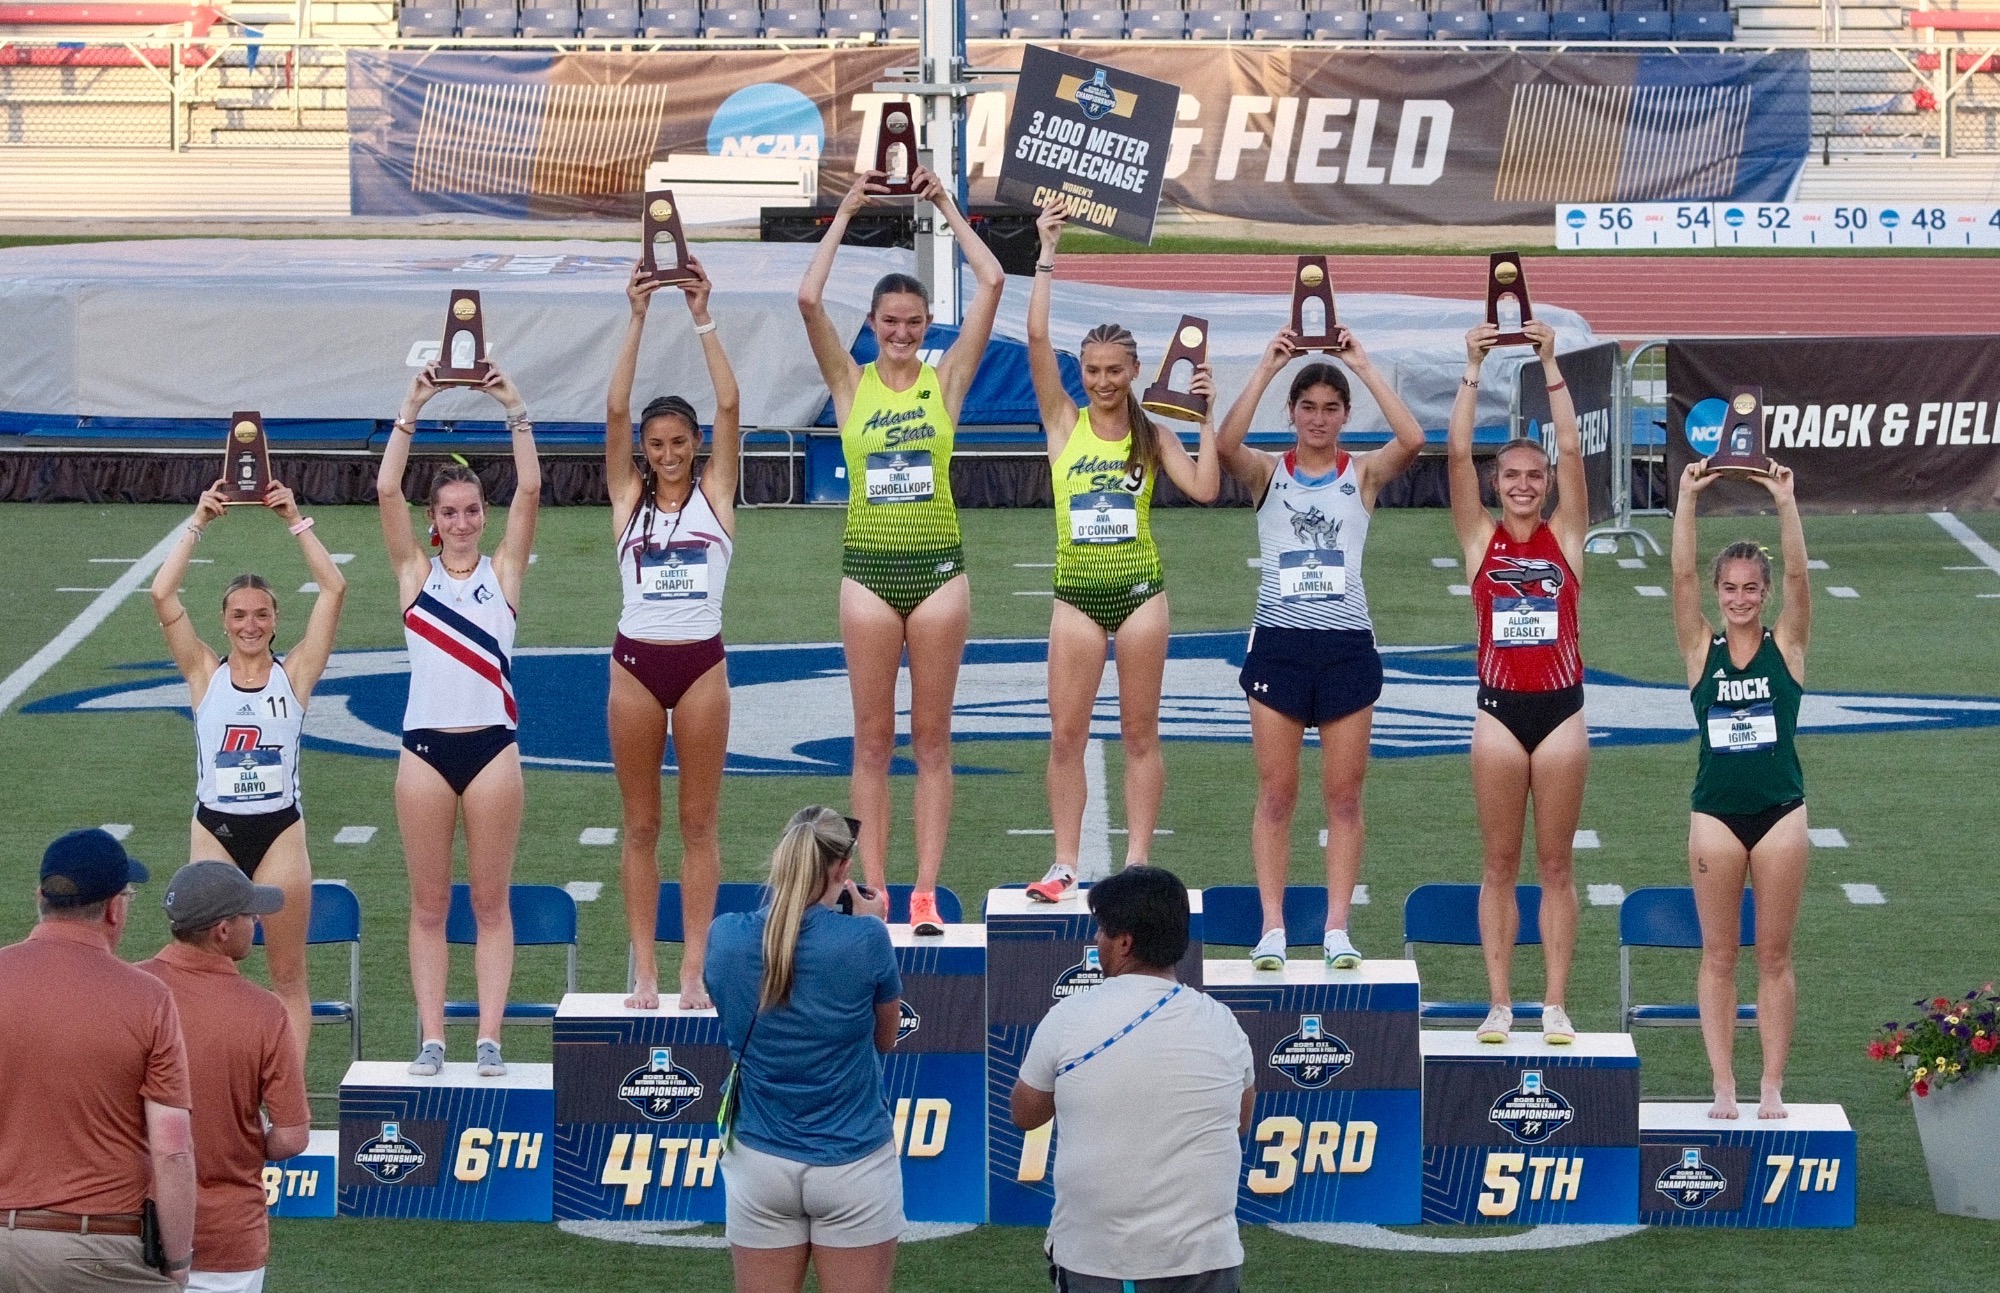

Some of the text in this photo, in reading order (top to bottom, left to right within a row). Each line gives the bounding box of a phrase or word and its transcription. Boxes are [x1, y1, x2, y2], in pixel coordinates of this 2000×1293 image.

[1028, 110, 1086, 147] 3,000
[1086, 126, 1150, 166] METER
[1215, 95, 1455, 186] FIELD
[719, 134, 820, 159] NCAA
[1015, 135, 1150, 194] STEEPLECHASE
[1061, 181, 1094, 199] WOMEN'S
[1599, 207, 1633, 230] 56
[1676, 206, 1711, 229] 54
[1757, 207, 1791, 229] 52
[1834, 207, 1868, 229] 50
[1911, 208, 1946, 230] 48
[862, 405, 926, 436] Adams
[1880, 403, 1910, 447] &
[885, 422, 936, 448] State
[1067, 454, 1125, 481] Adam
[889, 472, 910, 481] EMILY
[1125, 463, 1144, 492] 9
[869, 482, 932, 495] SCHOELLKOPF
[1096, 514, 1111, 522] AVA
[1078, 524, 1129, 536] O'CONNOR
[660, 569, 689, 578] ELIETTE
[1302, 571, 1324, 580] EMILY
[655, 579, 694, 590] CHAPUT
[1293, 581, 1334, 593] LAMENA
[1508, 616, 1540, 625] ALLISON
[1503, 627, 1546, 638] BEASLEY
[1717, 676, 1771, 701] ROCK
[266, 695, 288, 719] 11
[1728, 731, 1757, 743] IGIMS
[240, 772, 258, 781] ELLA
[234, 781, 266, 794] BARYO
[1271, 1053, 1352, 1065] CHAMPIONSHIPS
[620, 1086, 701, 1097] CHAMPIONSHIPS
[1491, 1109, 1572, 1120] CHAMPIONSHIPS
[357, 1153, 423, 1164] CHAMPIONSHIPS
[453, 1127, 544, 1181] 6TH
[1246, 1116, 1378, 1194] 3RD
[600, 1133, 720, 1206] 4TH
[1477, 1152, 1584, 1217] 5TH
[1657, 1180, 1725, 1190] CHAMPIONSHIPS
[1763, 1155, 1841, 1204] 7TH
